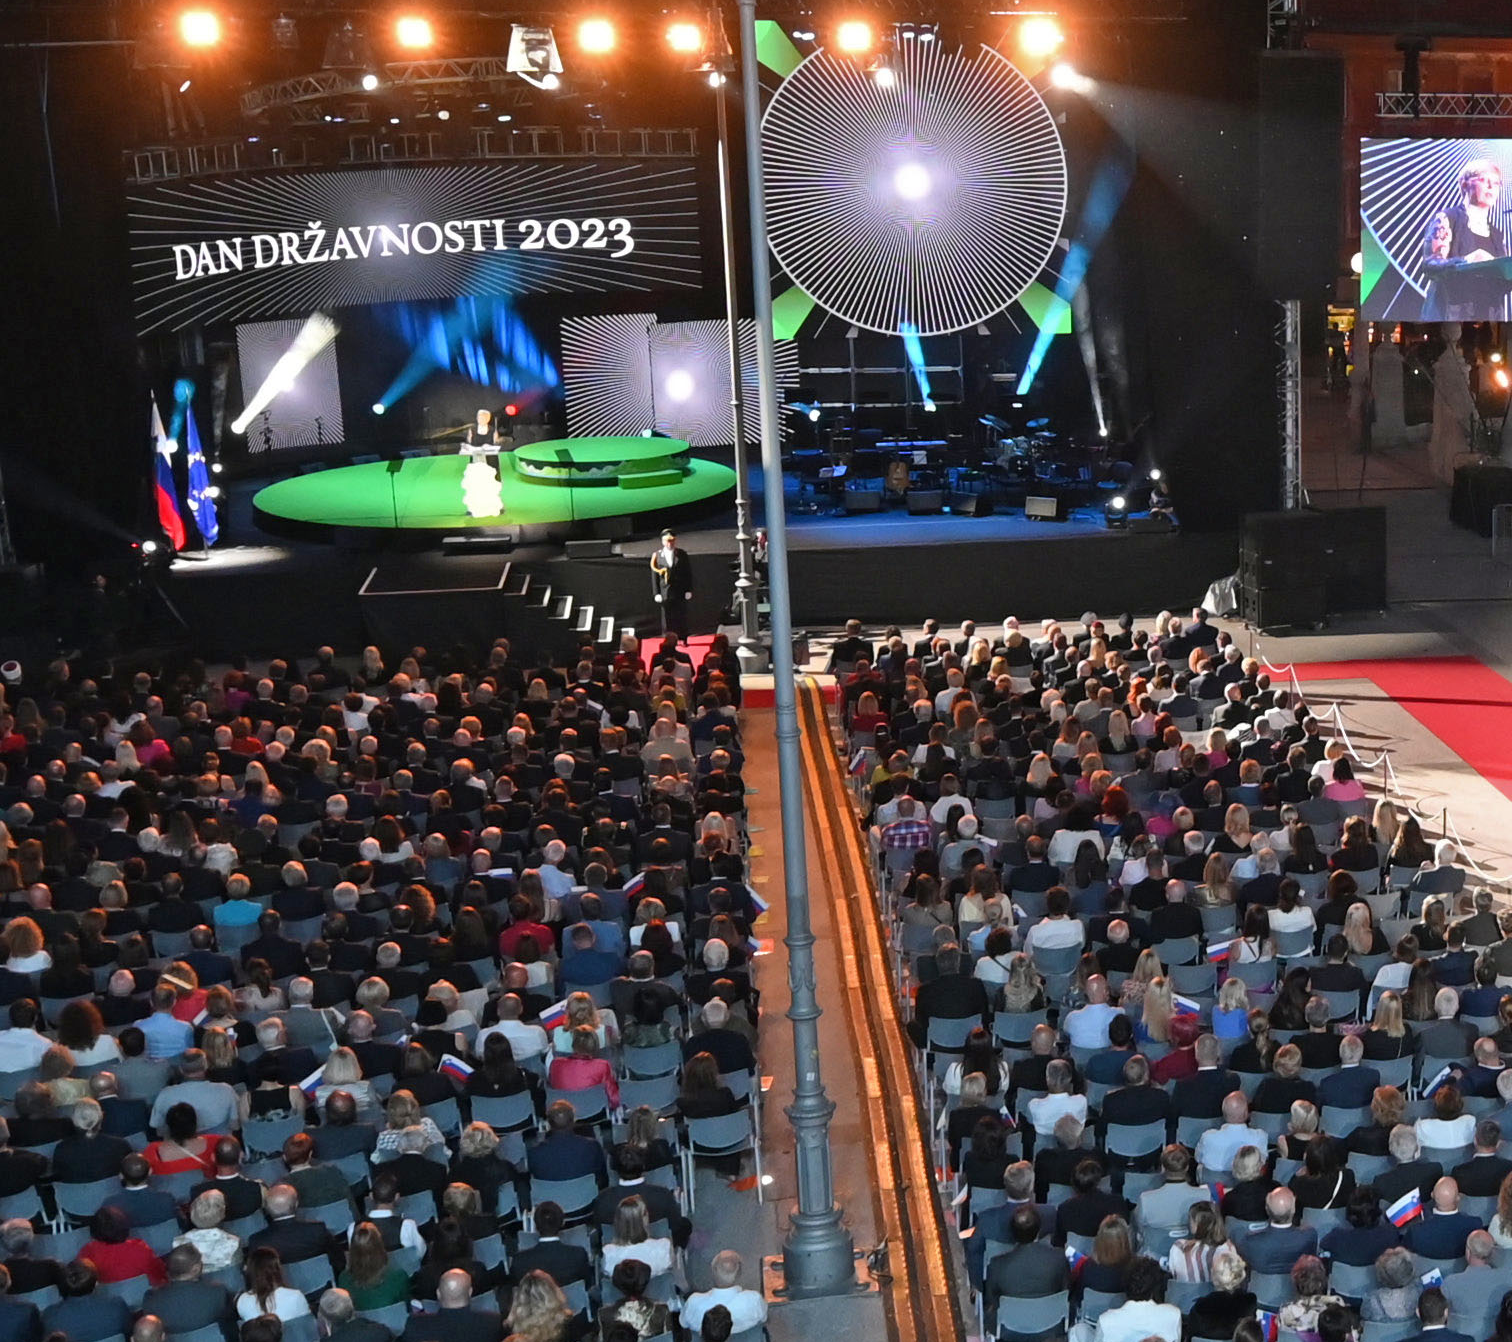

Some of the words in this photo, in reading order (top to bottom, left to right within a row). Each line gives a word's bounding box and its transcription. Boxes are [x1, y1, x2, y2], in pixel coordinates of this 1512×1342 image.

[172, 239, 243, 281] DAN
[251, 219, 506, 270] DRŽAVNOSTI
[518, 218, 635, 259] 2023
